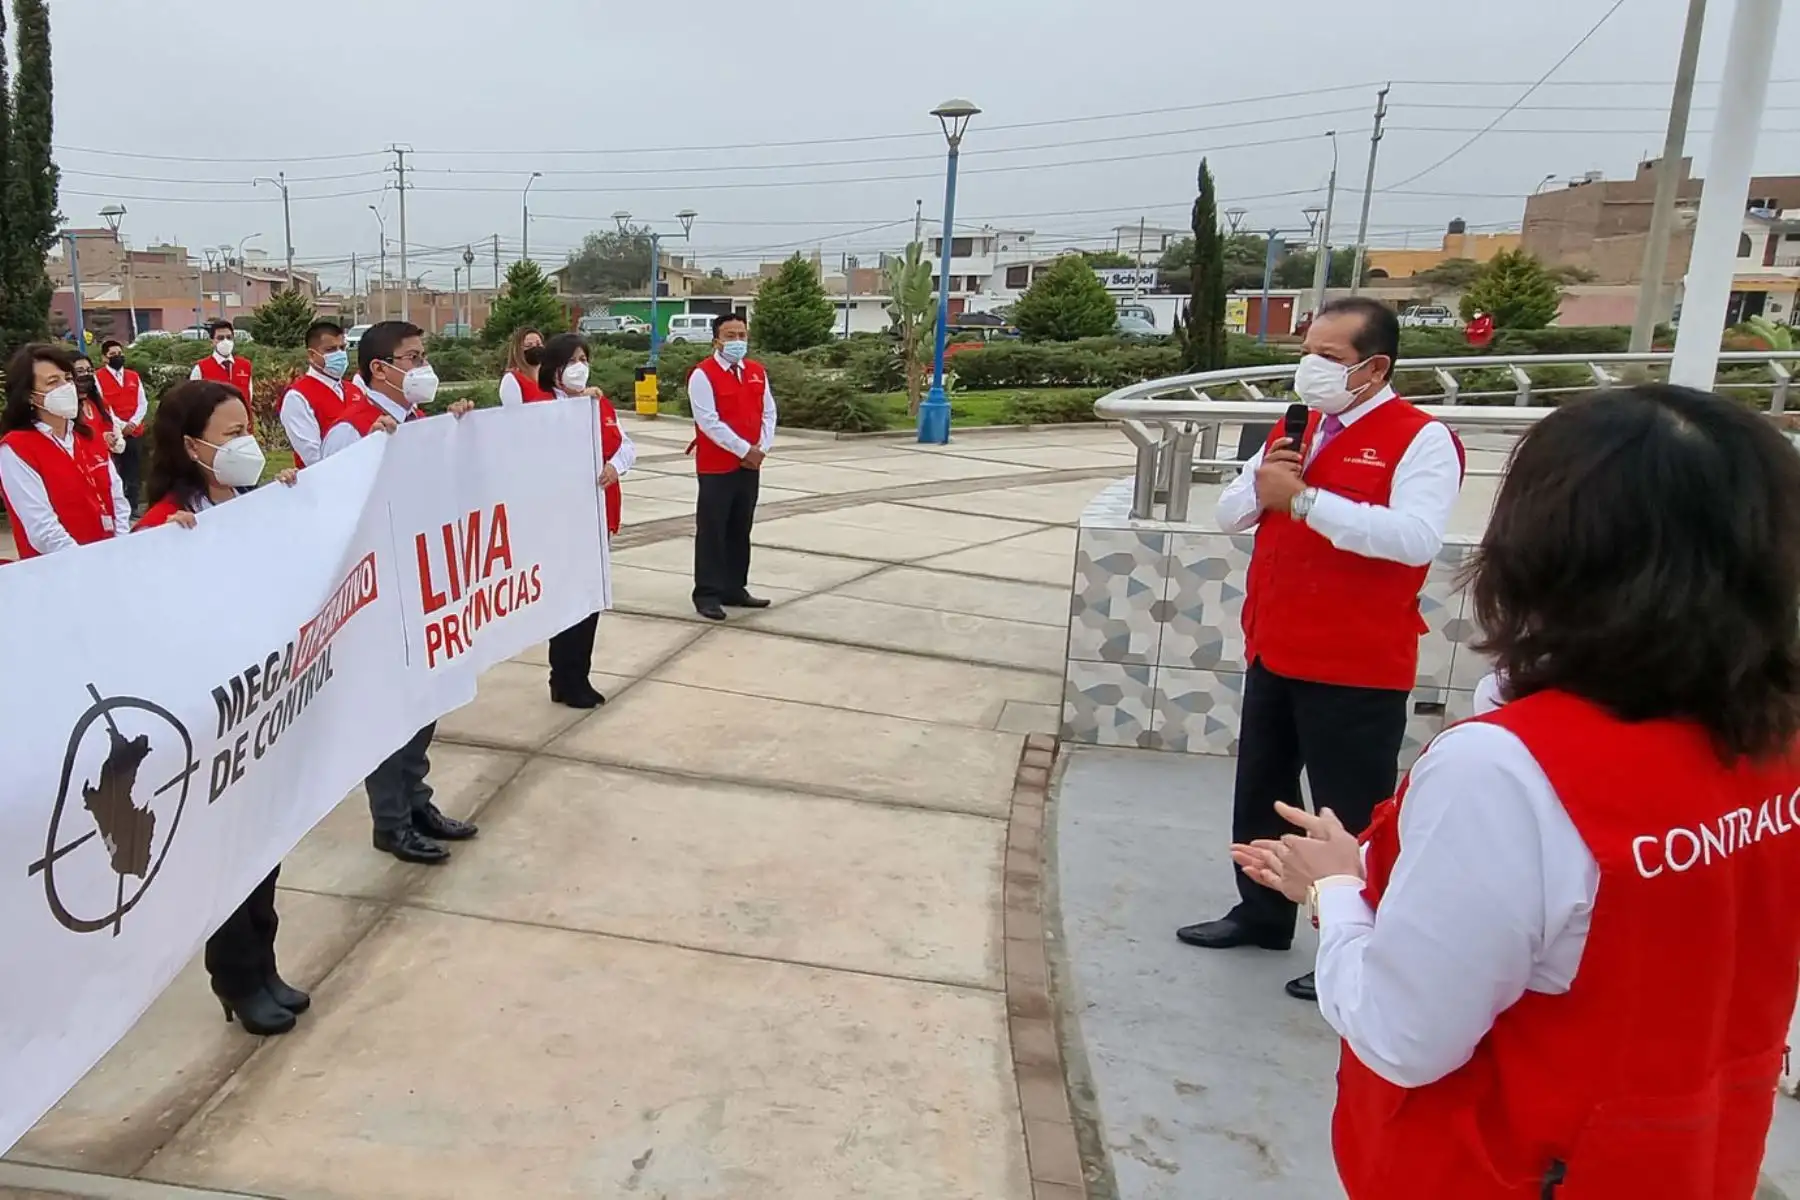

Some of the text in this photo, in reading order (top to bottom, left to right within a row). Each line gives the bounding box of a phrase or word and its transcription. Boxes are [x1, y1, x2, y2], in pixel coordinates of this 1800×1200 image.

[1112, 273, 1154, 285] School
[415, 503, 512, 615] LIMA
[208, 643, 334, 805] DE CONTROL
